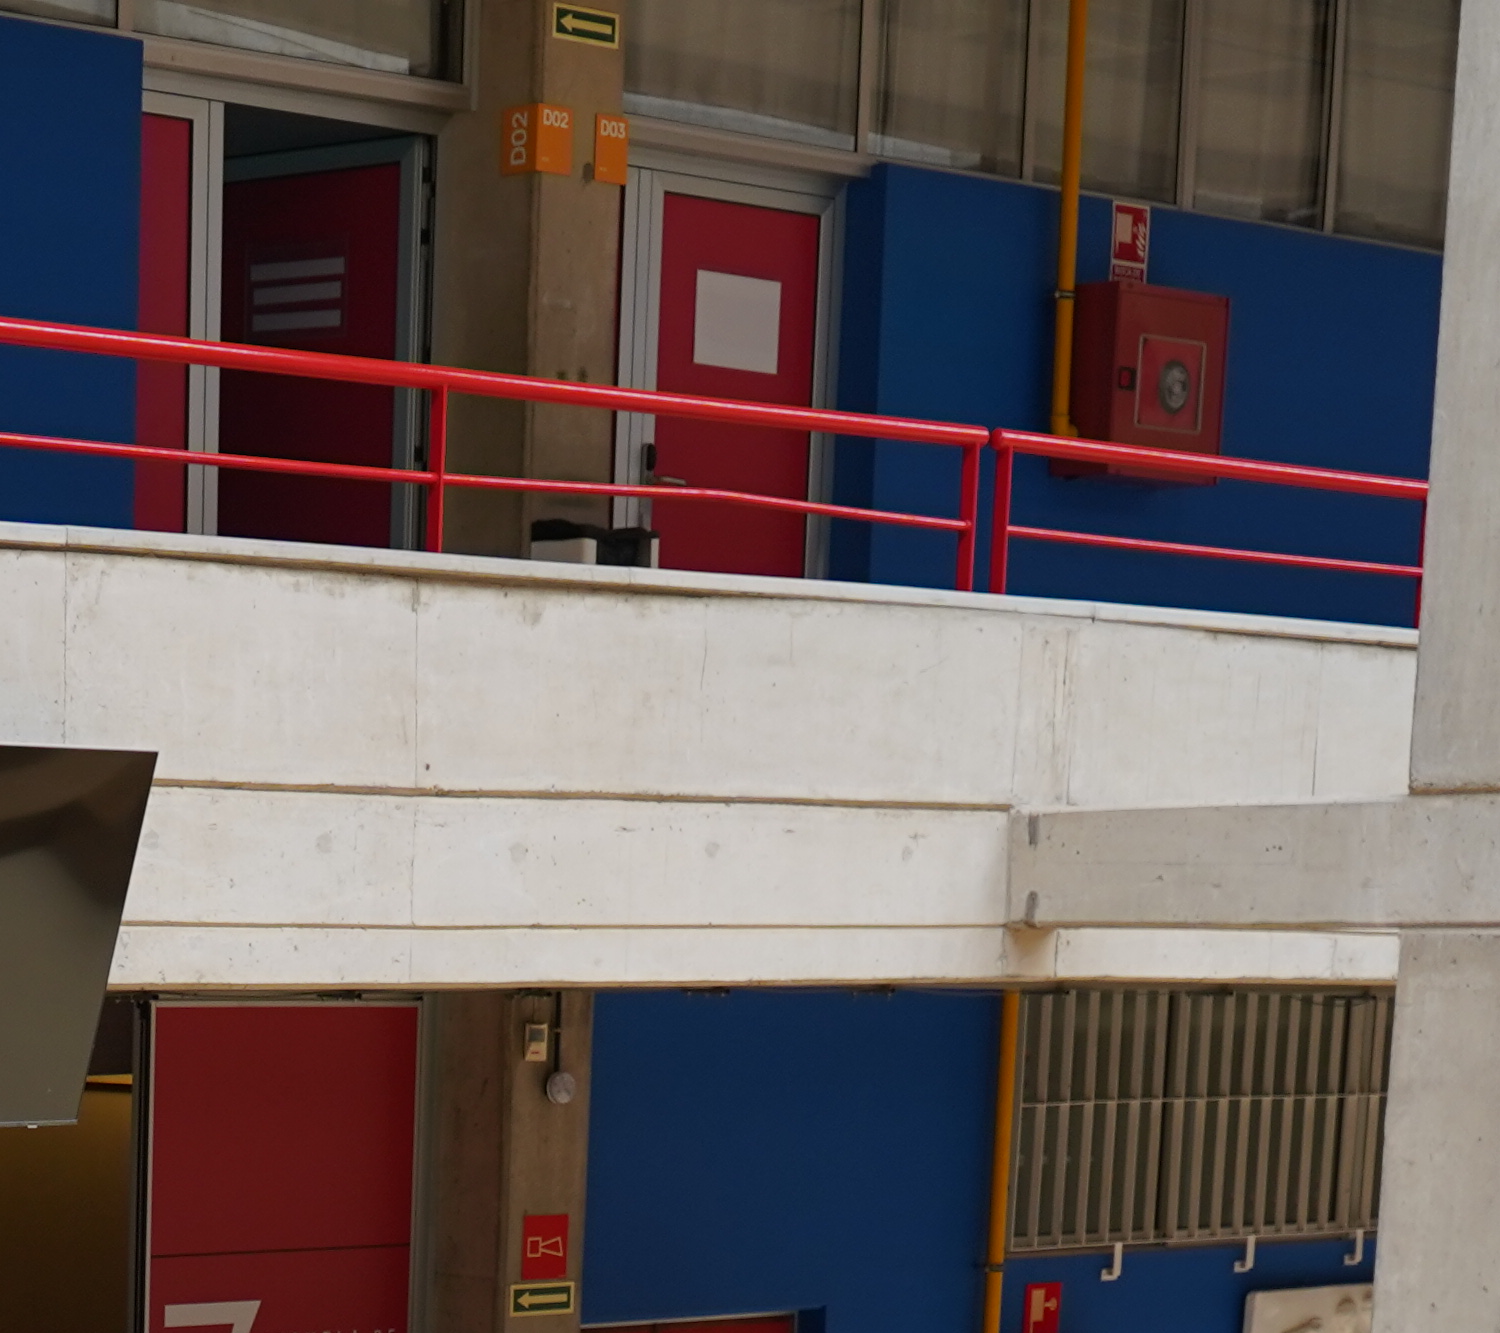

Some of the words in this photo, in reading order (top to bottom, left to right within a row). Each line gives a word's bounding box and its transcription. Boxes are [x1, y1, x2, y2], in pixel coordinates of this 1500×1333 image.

[543, 109, 569, 128] D02
[510, 111, 528, 166] D02
[600, 119, 626, 139] D03
